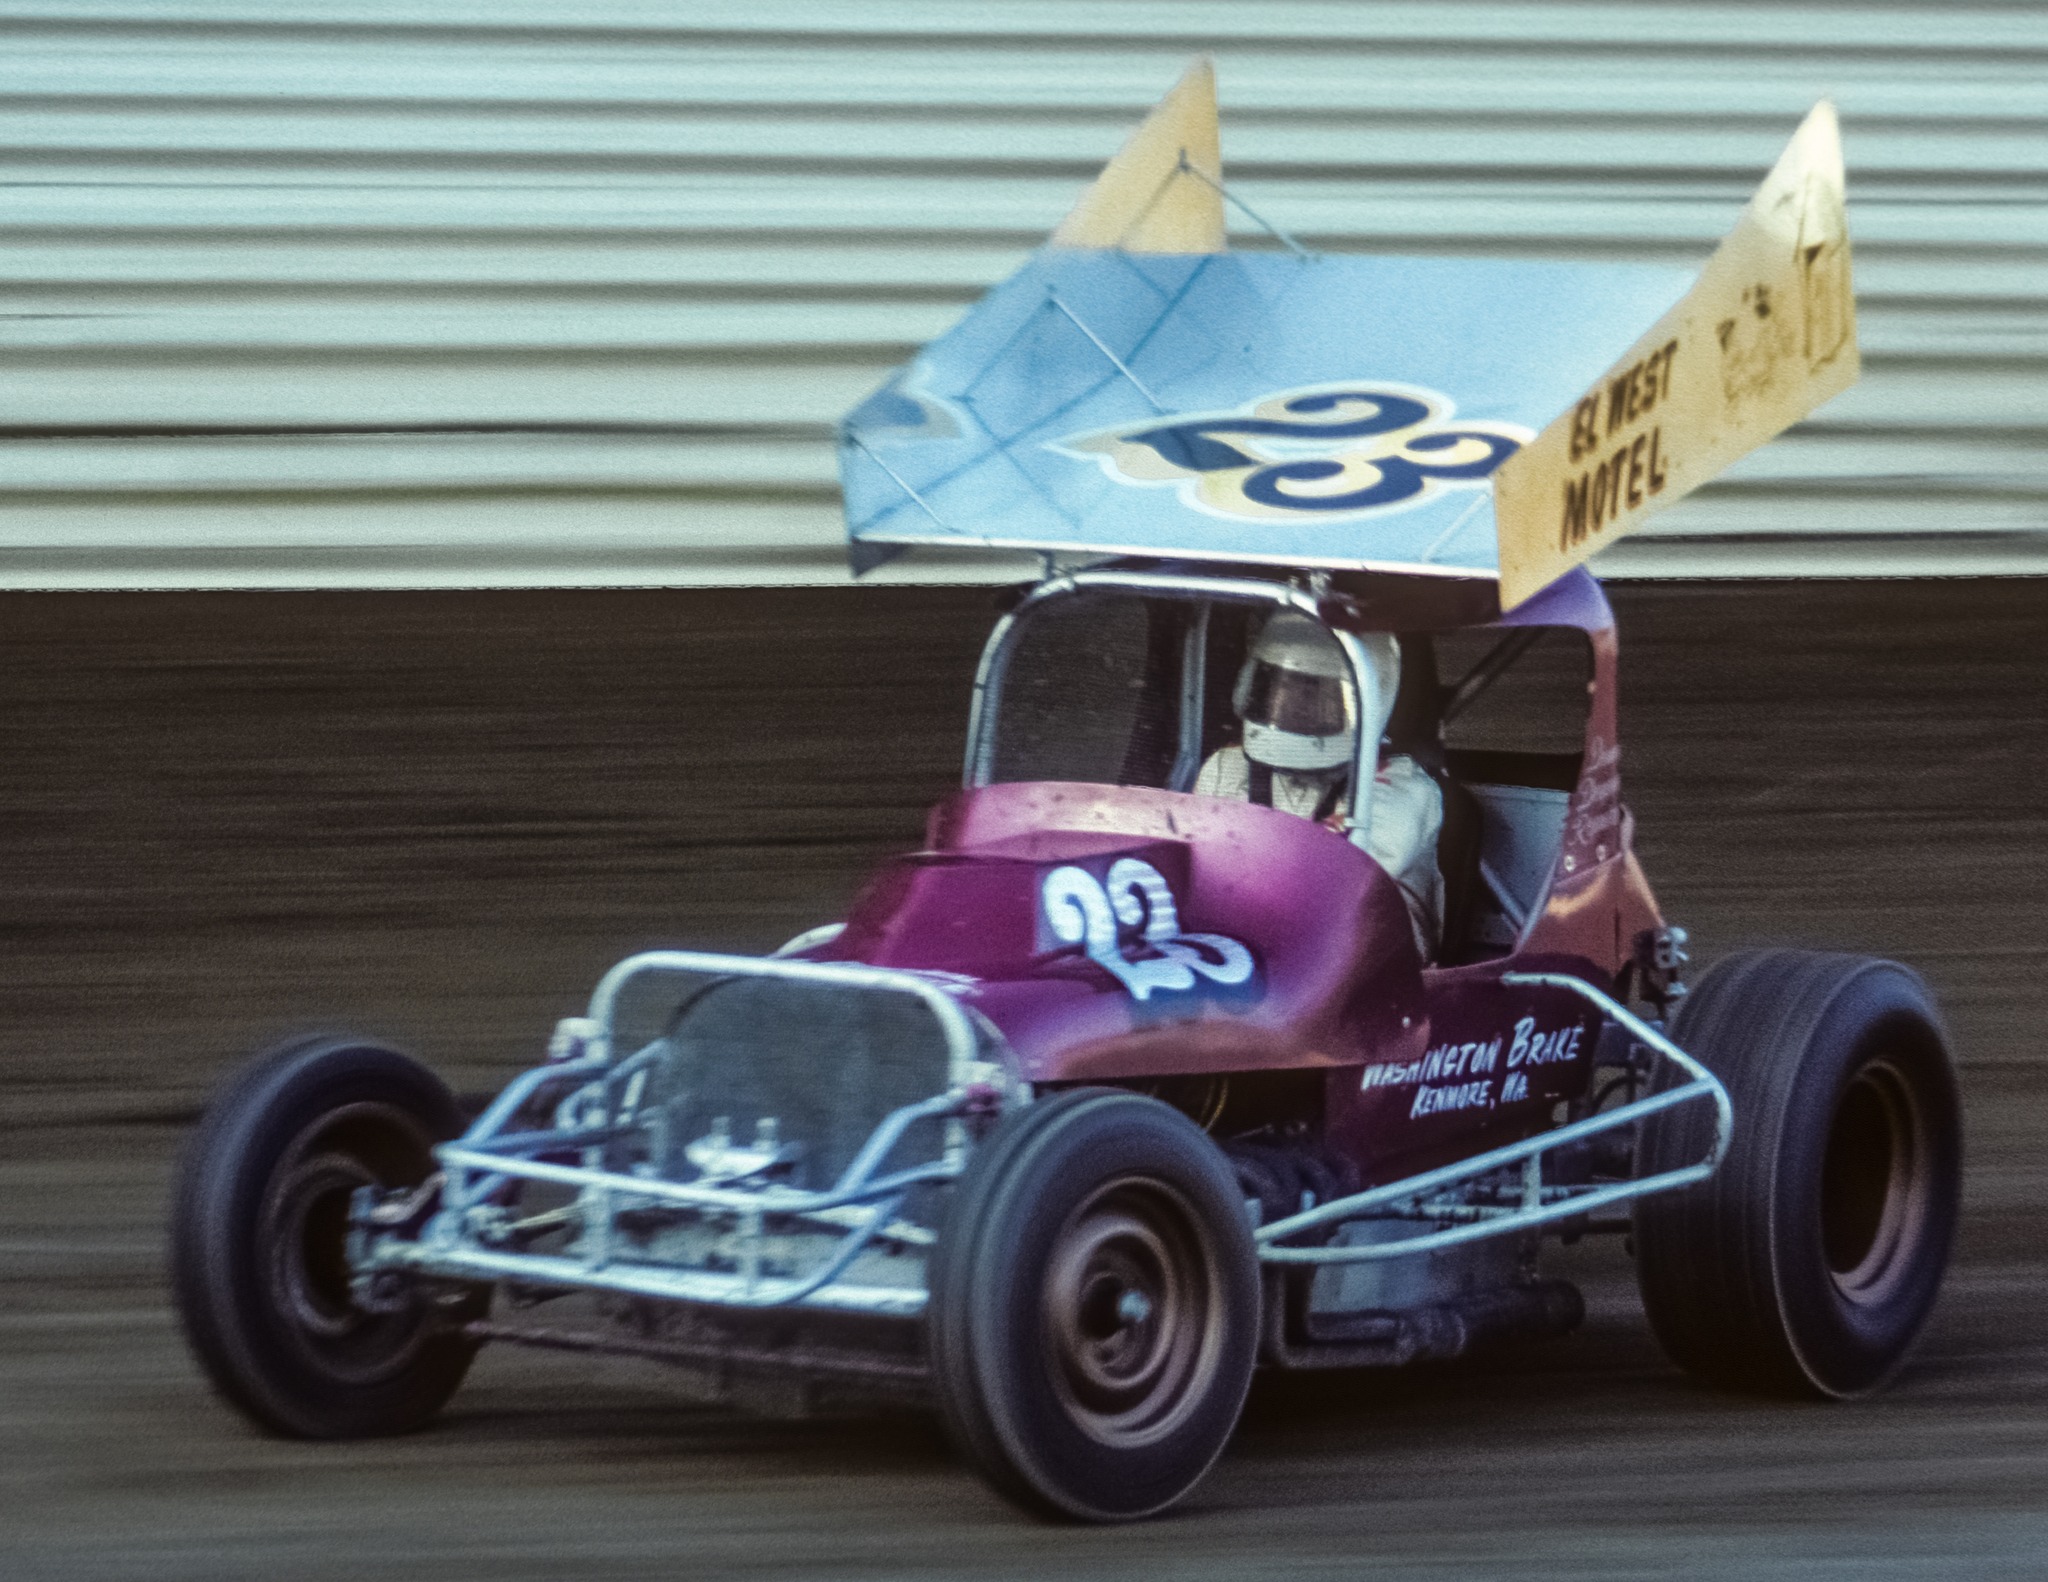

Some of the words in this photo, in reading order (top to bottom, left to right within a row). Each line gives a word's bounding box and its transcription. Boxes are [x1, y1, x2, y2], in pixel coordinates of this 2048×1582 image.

[1100, 388, 1525, 516] 23
[1569, 390, 1601, 465] EL
[1606, 337, 1679, 439] WEST
[1559, 424, 1666, 554] MOTEL
[1041, 857, 1255, 1001] 23
[1360, 1037, 1503, 1091] WASHINGTON
[1505, 1015, 1585, 1069] BRAKE
